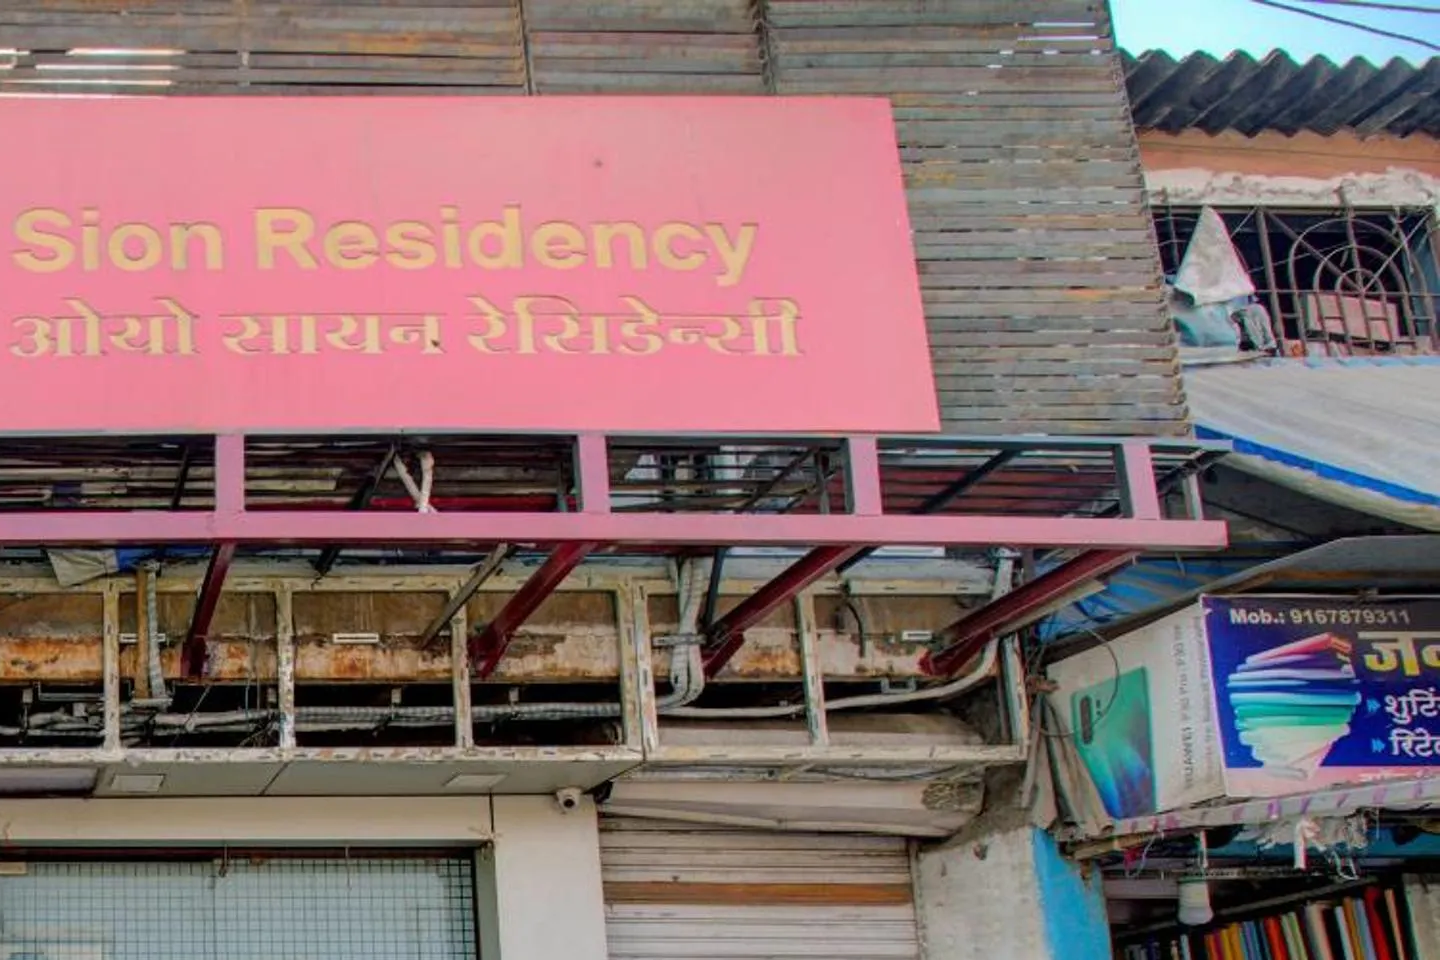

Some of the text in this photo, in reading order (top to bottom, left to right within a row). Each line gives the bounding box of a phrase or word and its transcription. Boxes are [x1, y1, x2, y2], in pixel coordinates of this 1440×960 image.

[11, 203, 761, 287] Sion Residency
[8, 297, 201, 358] ओयो
[217, 310, 447, 357] सायन
[1289, 607, 1411, 625] 9167879311
